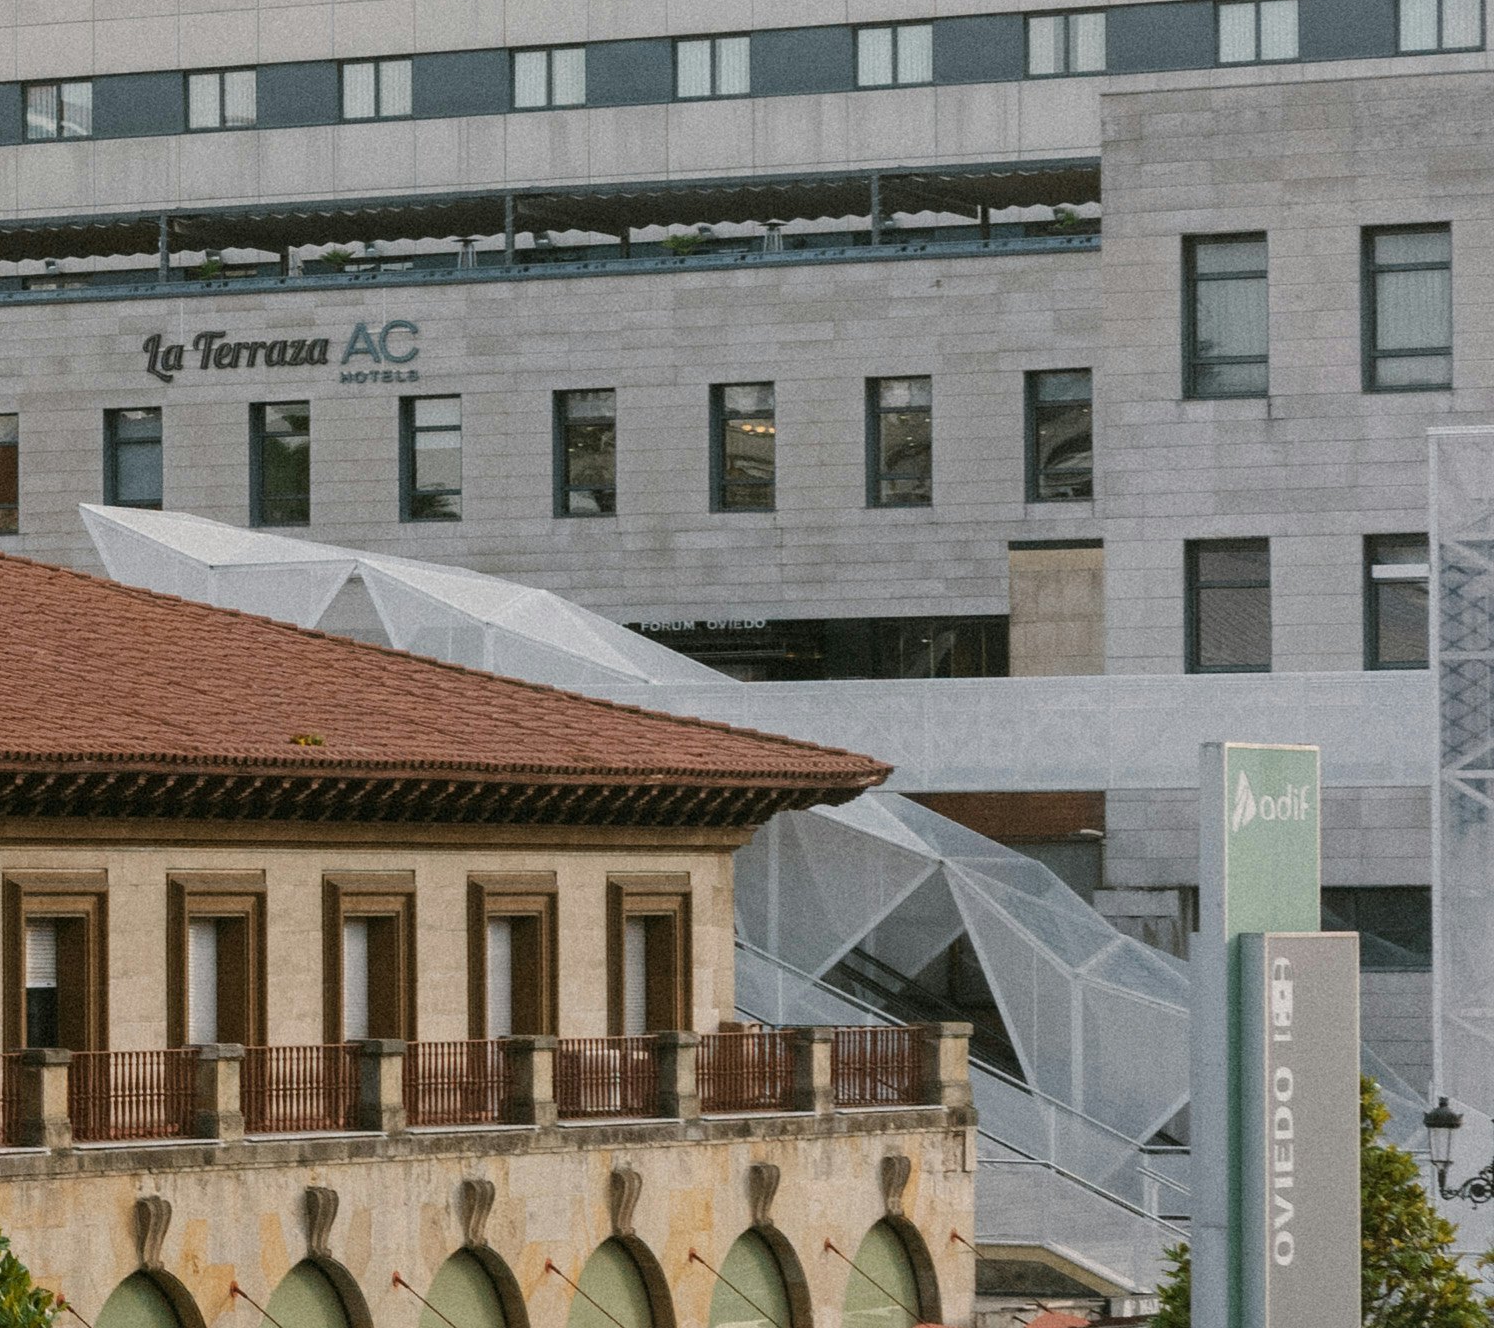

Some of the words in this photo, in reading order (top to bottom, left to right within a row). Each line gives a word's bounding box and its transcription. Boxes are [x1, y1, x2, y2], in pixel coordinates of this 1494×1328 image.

[142, 333, 185, 383] La
[192, 330, 330, 370] Terraza
[340, 319, 420, 365] AC
[339, 369, 420, 384] HOTELS
[640, 621, 696, 632] FORUM
[706, 620, 766, 630] OVIEDO
[1259, 783, 1310, 821] adif
[1273, 1066, 1295, 1267] OVIEDO
